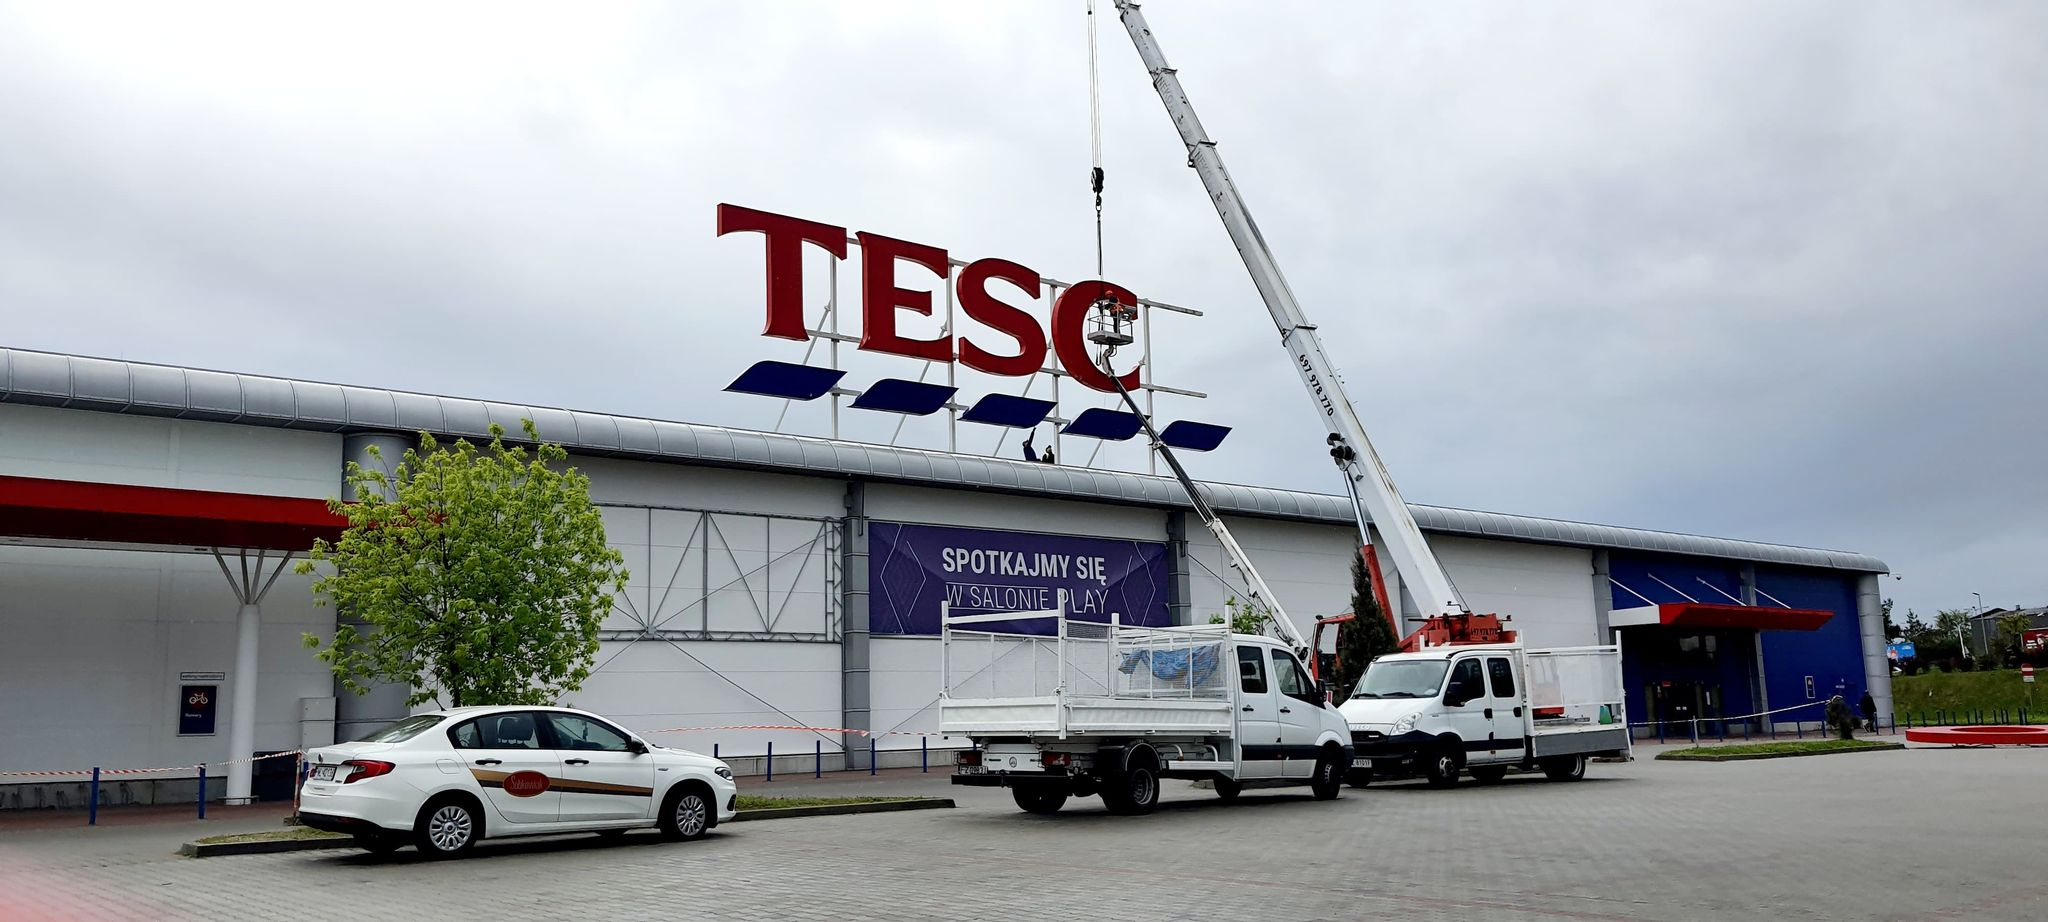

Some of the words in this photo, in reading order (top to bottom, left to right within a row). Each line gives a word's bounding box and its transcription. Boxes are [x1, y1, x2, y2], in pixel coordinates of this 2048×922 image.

[716, 202, 1141, 393] TESC
[1299, 354, 1312, 373] 697
[1309, 374, 1323, 395] 978
[1320, 395, 1334, 417] 770
[942, 547, 1070, 579] SPOTKAJMY
[1076, 556, 1107, 586] SIĘ
[946, 585, 962, 607] W
[970, 586, 1050, 610] SALONIE
